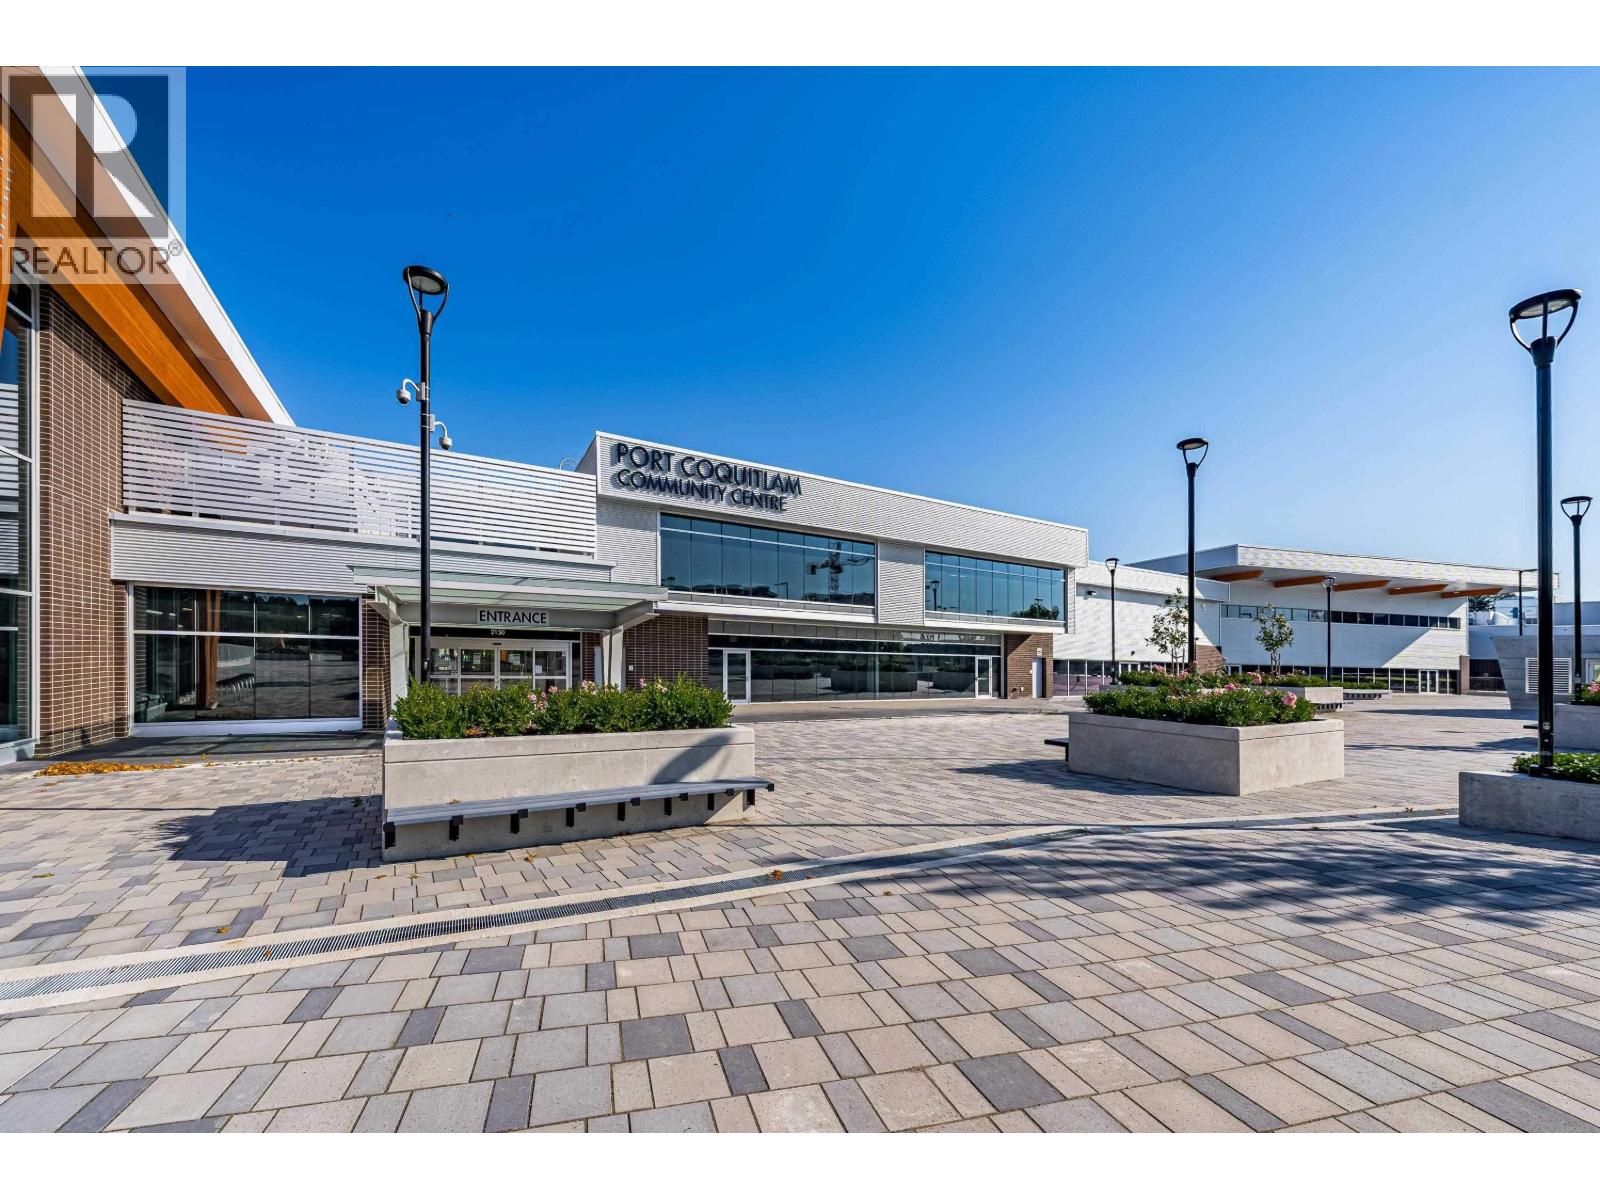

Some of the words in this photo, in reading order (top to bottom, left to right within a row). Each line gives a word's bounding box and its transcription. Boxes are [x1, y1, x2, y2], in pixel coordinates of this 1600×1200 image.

[617, 442, 675, 472] PORT
[680, 456, 802, 495] COQUITLAM
[617, 468, 727, 501] COMMUNITY
[731, 488, 788, 511] CENTRE
[479, 610, 547, 624] ENTRANCE
